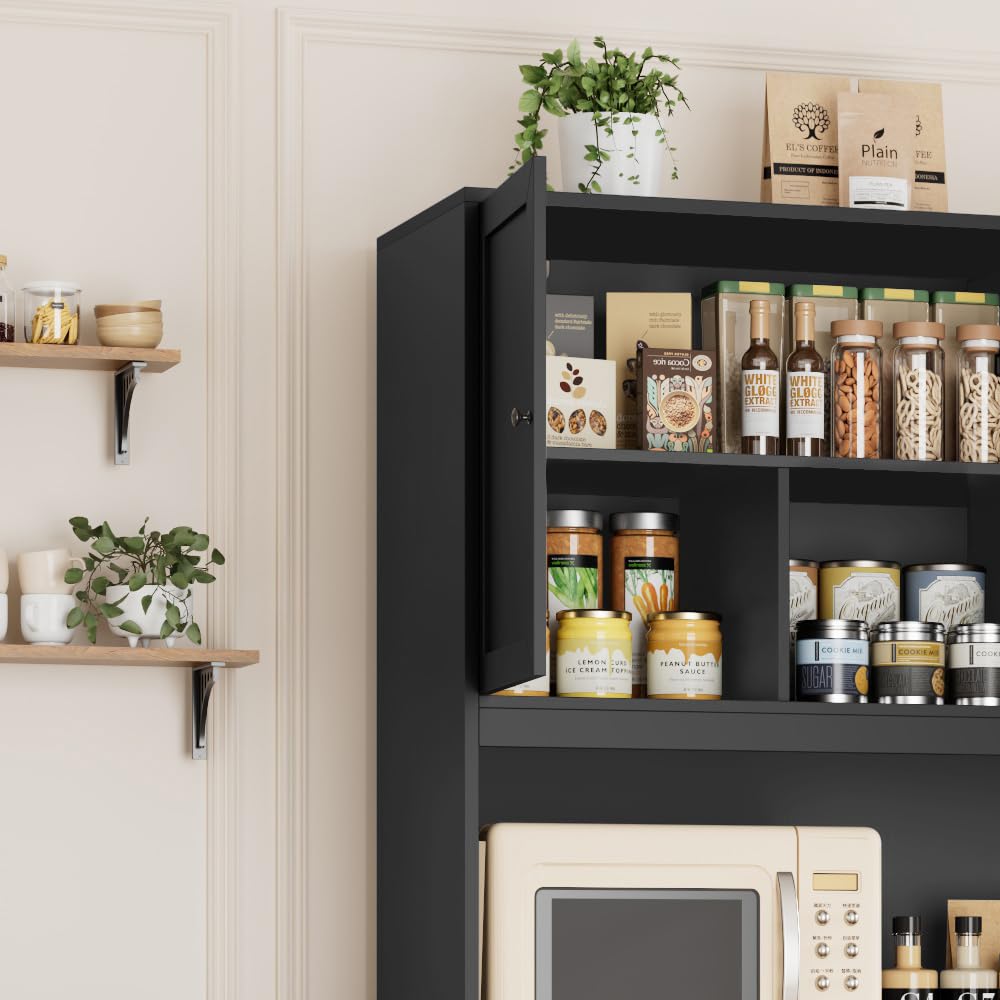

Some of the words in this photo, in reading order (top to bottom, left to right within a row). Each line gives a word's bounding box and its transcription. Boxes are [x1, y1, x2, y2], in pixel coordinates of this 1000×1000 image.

[786, 143, 805, 152] EL'S
[861, 144, 898, 160] Plain
[779, 166, 806, 174] PRODUCT
[744, 373, 777, 385] WHITE
[790, 375, 823, 387] WHITE
[898, 648, 927, 656] COOKIE
[801, 665, 833, 689] SUGAR
